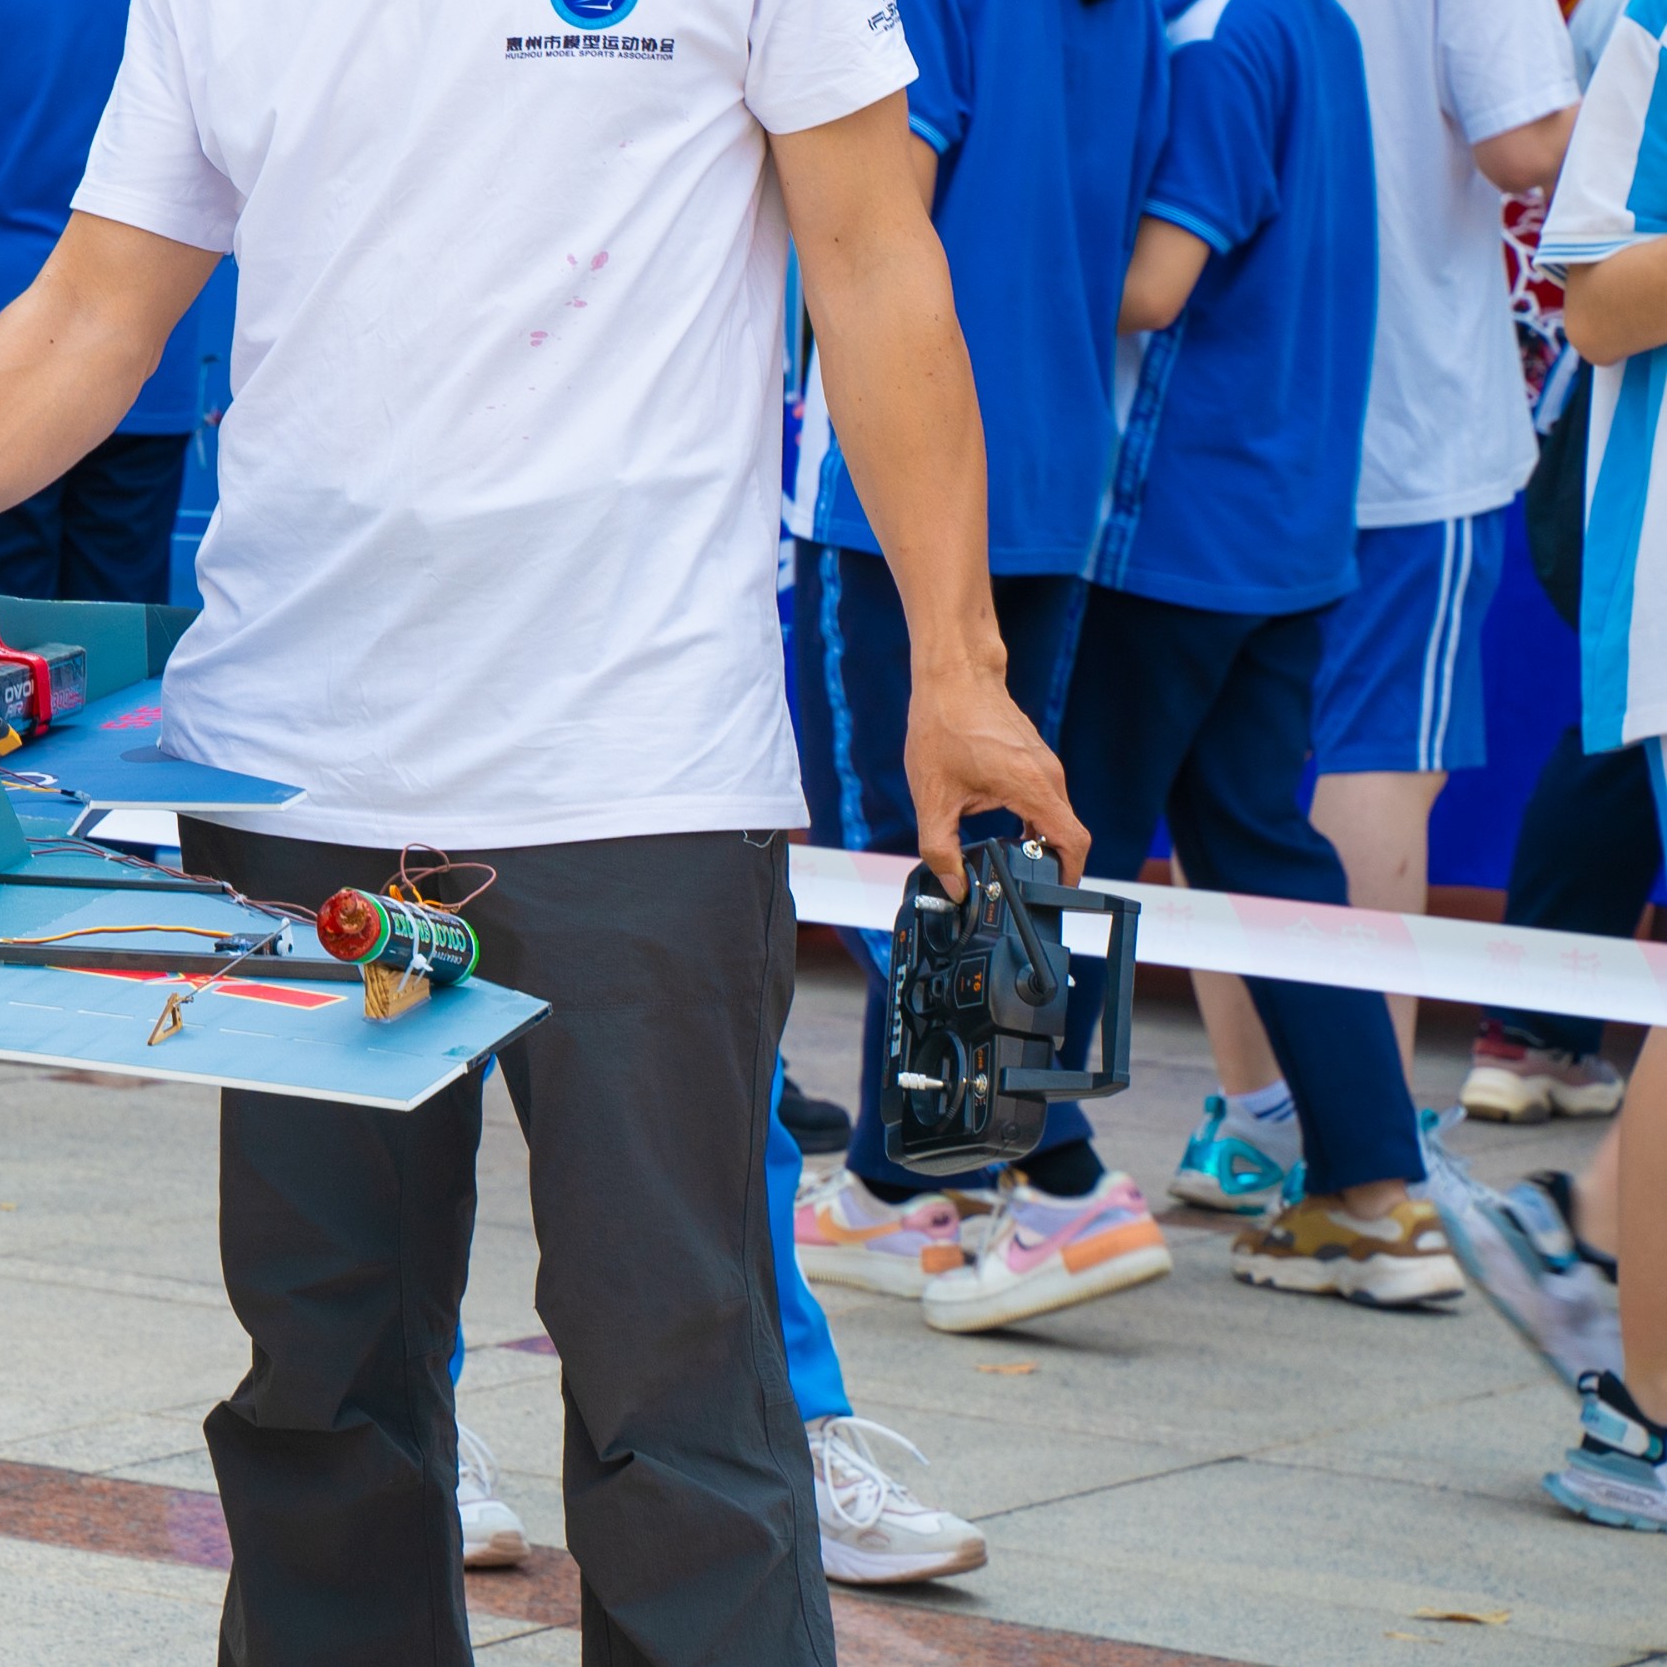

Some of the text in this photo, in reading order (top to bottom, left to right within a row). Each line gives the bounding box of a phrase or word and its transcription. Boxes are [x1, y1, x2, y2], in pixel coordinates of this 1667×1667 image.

[506, 34, 675, 53] 惠州市模型运动协会
[505, 50, 674, 61] HUIZHOU MODEL SPORTS ASSOCIATION
